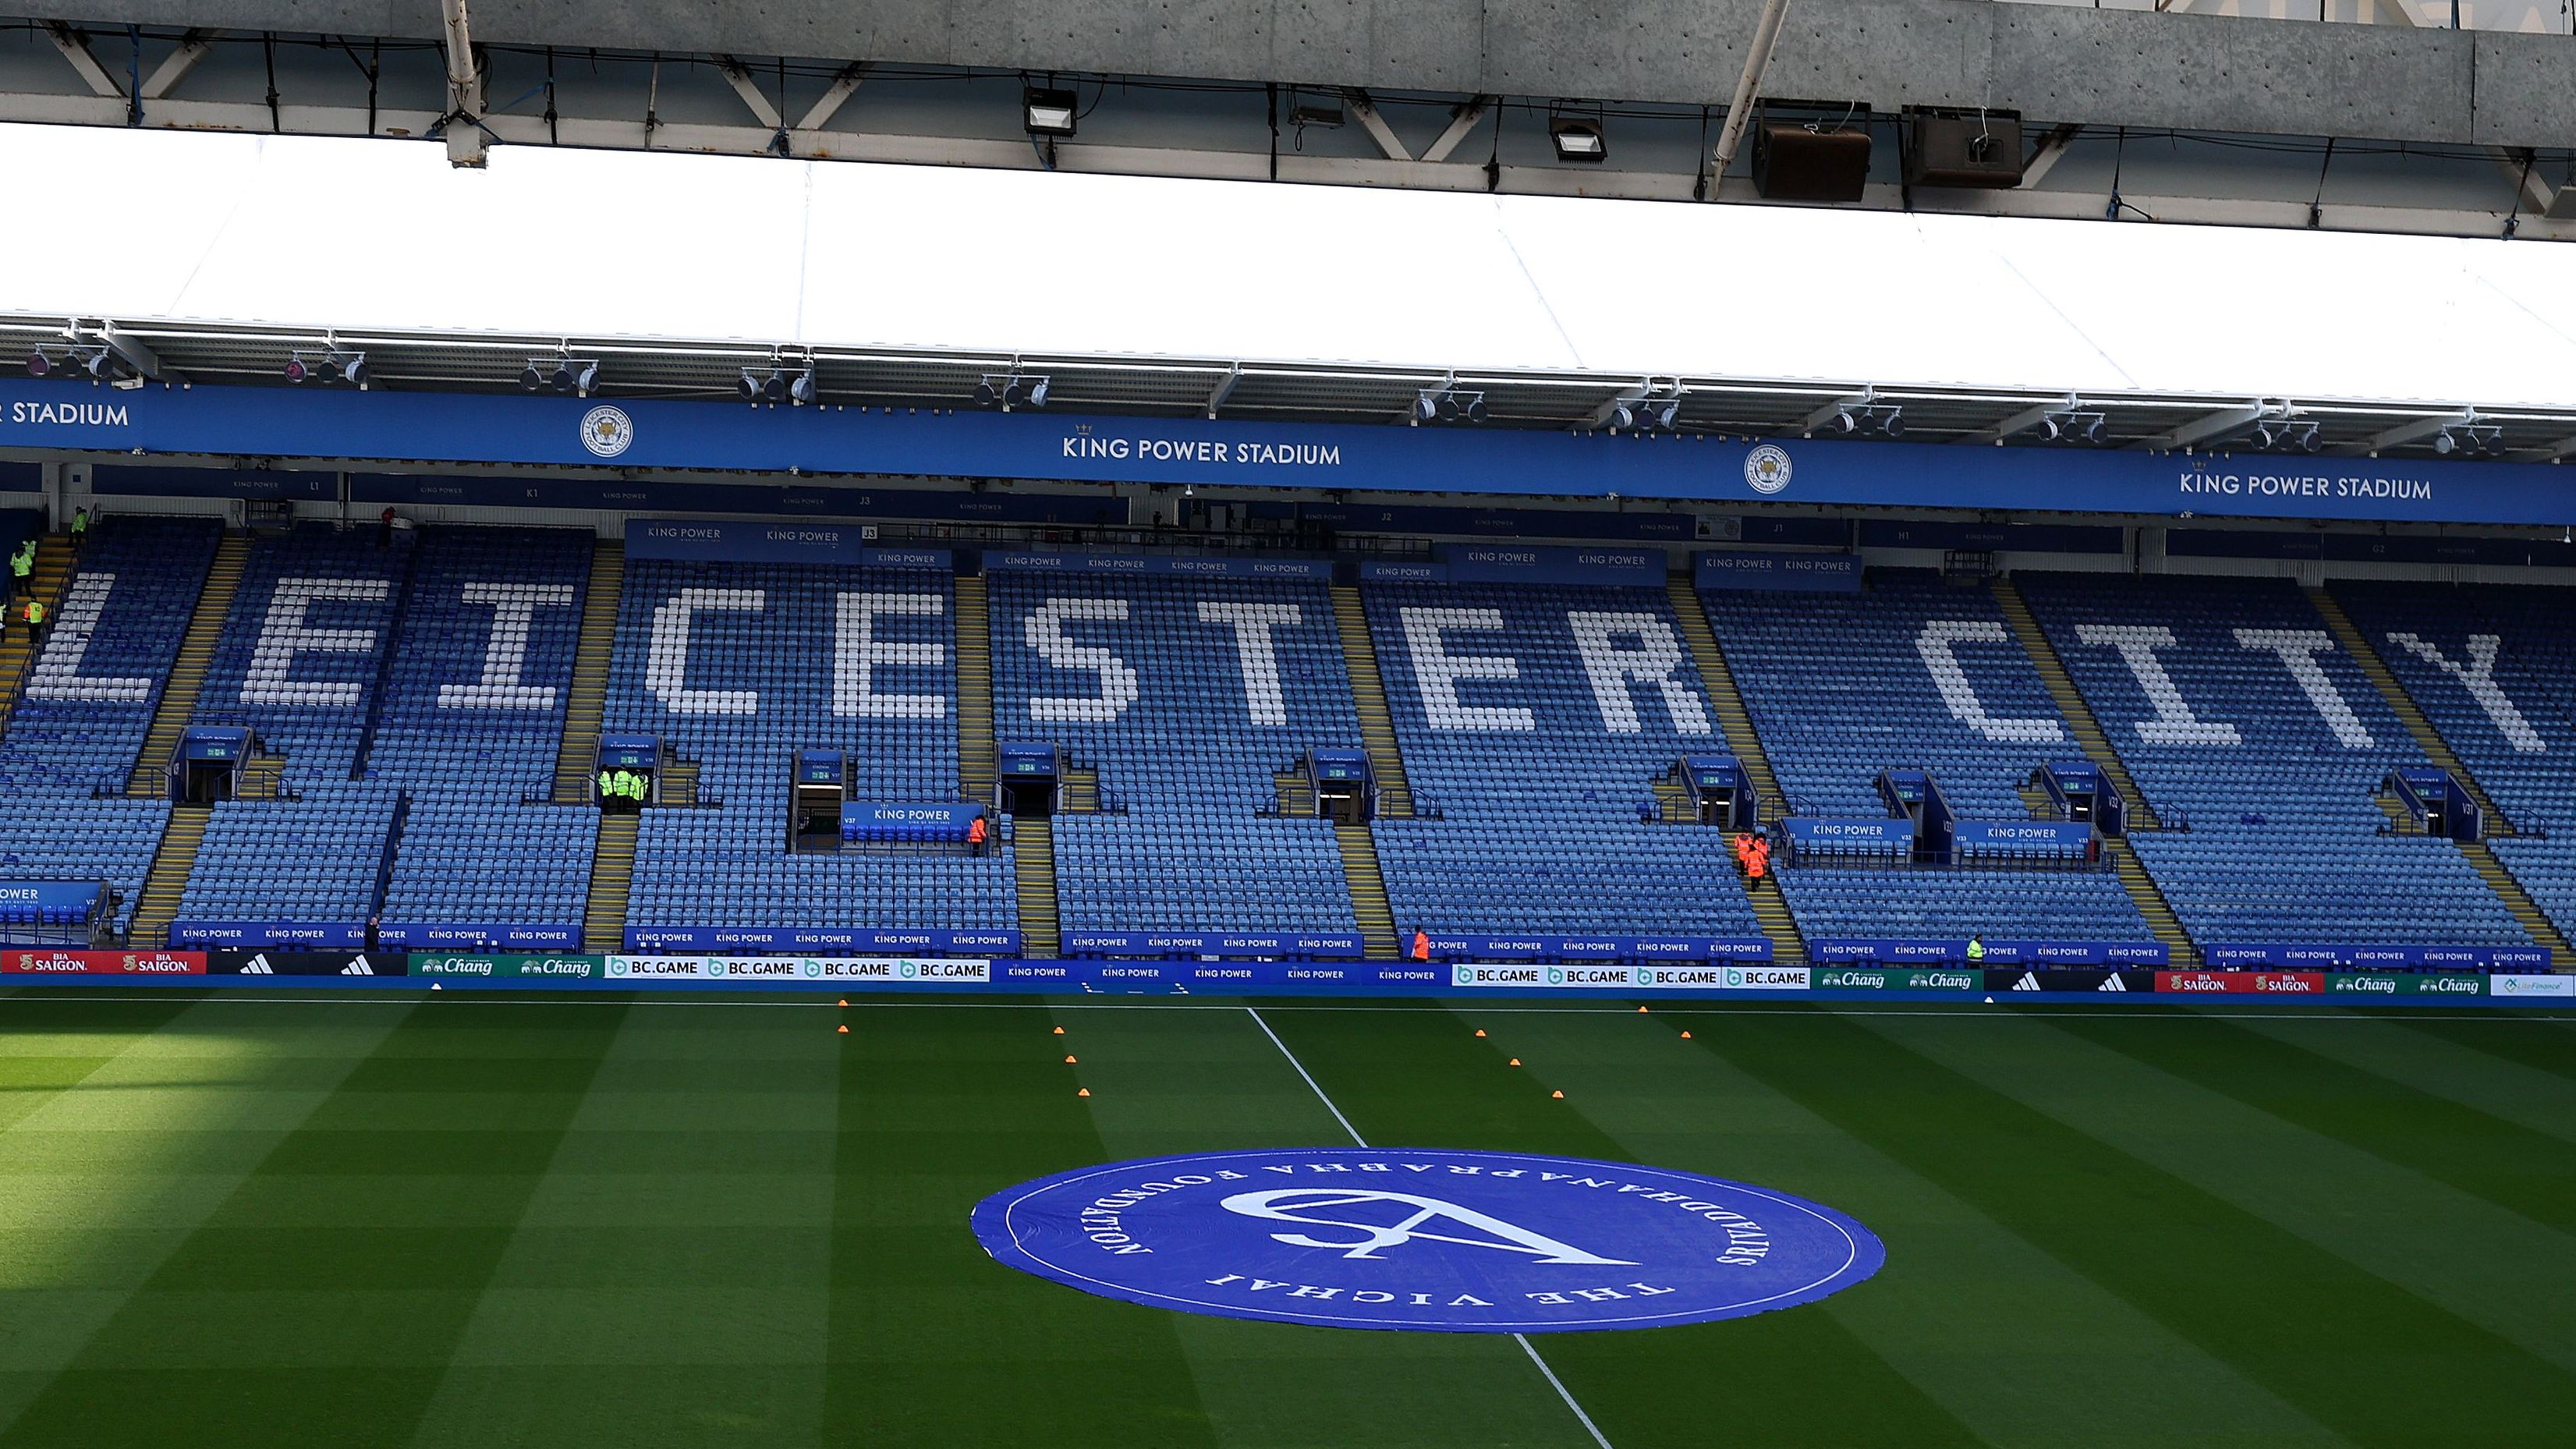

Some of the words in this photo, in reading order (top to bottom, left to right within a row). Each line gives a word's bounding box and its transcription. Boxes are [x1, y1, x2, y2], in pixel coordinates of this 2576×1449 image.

[12, 402, 129, 426] STADIUM
[1063, 438, 1129, 459] KING
[1139, 440, 1228, 462] POWER
[1236, 443, 1340, 465] STADIUM
[2181, 473, 2240, 494] KING
[2248, 476, 2330, 496] POWER
[2337, 477, 2431, 500] STADIUM
[648, 527, 678, 537] KING
[681, 528, 721, 538] POWER
[767, 530, 796, 540] KING
[799, 531, 838, 541] POWER
[864, 529, 875, 537] J3
[878, 554, 902, 562] KING
[903, 554, 935, 563] POWER
[1005, 557, 1028, 565] KING
[1029, 557, 1061, 566] POWER
[1468, 552, 1496, 562] KING
[1498, 552, 1536, 562] POWER
[1579, 554, 1606, 564] KING
[1608, 555, 1646, 565] POWER
[1088, 559, 1111, 568] KING
[1113, 560, 1144, 569] POWER
[1171, 562, 1194, 570] KING
[1196, 562, 1227, 571] POWER
[1706, 558, 1733, 568] KING
[1736, 559, 1772, 569] POWER
[1785, 561, 1812, 570] KING
[1815, 561, 1851, 571] POWER
[1254, 564, 1277, 572] KING
[1278, 565, 1309, 573] POWER
[1400, 568, 1430, 576] POWER
[26, 572, 1713, 735] LEICESTER
[1914, 619, 2547, 753] CITY
[874, 810, 905, 820] KING
[909, 810, 950, 820] POWER
[1813, 825, 1841, 835] KING
[1844, 825, 1883, 835] POWER
[1987, 827, 2016, 838] KING
[2018, 828, 2057, 838] POWER
[0, 888, 38, 900] OWER
[265, 930, 290, 938] KING
[292, 930, 324, 938] POWER
[347, 930, 366, 939] KIN
[378, 930, 406, 939] OWER
[429, 930, 453, 939] KING
[455, 930, 487, 939] POWER
[509, 931, 533, 940] KING
[535, 931, 567, 940] POWER
[636, 933, 661, 941] KING
[661, 934, 693, 942] POWER
[716, 934, 739, 942] KING
[795, 934, 819, 943] KING
[874, 935, 898, 944] KING
[952, 936, 976, 944] KING
[1097, 938, 1128, 947] POWER
[1148, 938, 1171, 947] KING
[1172, 938, 1203, 947] POWER
[1322, 940, 1352, 948] POWER
[1437, 941, 1468, 950] POWER
[1489, 941, 1511, 950] KING
[1563, 942, 1585, 951] KING
[1636, 943, 1658, 951] KING
[1733, 944, 1762, 953] POWER
[1894, 946, 1916, 955] KING
[2038, 948, 2059, 956] KING
[2060, 948, 2088, 956] POWER
[2131, 948, 2159, 957] POWER
[2216, 950, 2238, 958] KING
[2239, 950, 2266, 958] POWER
[2286, 951, 2307, 959] KING
[2308, 951, 2336, 959] POWER
[2355, 951, 2376, 960] KING
[2377, 951, 2404, 960] POWER
[2424, 952, 2444, 961] KING
[2446, 952, 2473, 961] POWER
[2493, 953, 2513, 962] KING
[2514, 953, 2542, 962] POWER
[444, 958, 493, 976] Chang
[543, 958, 591, 977] Chang
[632, 961, 698, 974] BC.GAME
[728, 962, 795, 975] BC.GAME
[825, 963, 890, 976] BC.GAME
[920, 964, 985, 977] BC.GAME
[1008, 968, 1032, 976] KING
[1034, 968, 1066, 976] POWER
[1102, 969, 1126, 977] KING
[1128, 969, 1159, 977] POWER
[1195, 969, 1218, 978] KING
[1221, 969, 1252, 978] POWER
[1288, 970, 1311, 979] KING
[1313, 970, 1344, 979] POWER
[1379, 971, 1402, 980] KING
[1404, 971, 1435, 980] POWER
[1476, 969, 1538, 982] BC.GAME
[1567, 970, 1628, 983] BC.GAME
[1657, 971, 1717, 983] BC.GAME
[1745, 972, 1805, 984] BC.GAME
[1841, 972, 1885, 989] Chang
[1929, 972, 1972, 990] Chang
[2355, 976, 2396, 994] Chang
[2438, 977, 2479, 994] Chang
[1080, 1169, 1249, 1255] FOUNDATION
[1261, 1163, 1772, 1267] SRIVADDHANAPRABHA
[1205, 1273, 1495, 1307] VICHAI
[1524, 1281, 1676, 1306] THE
